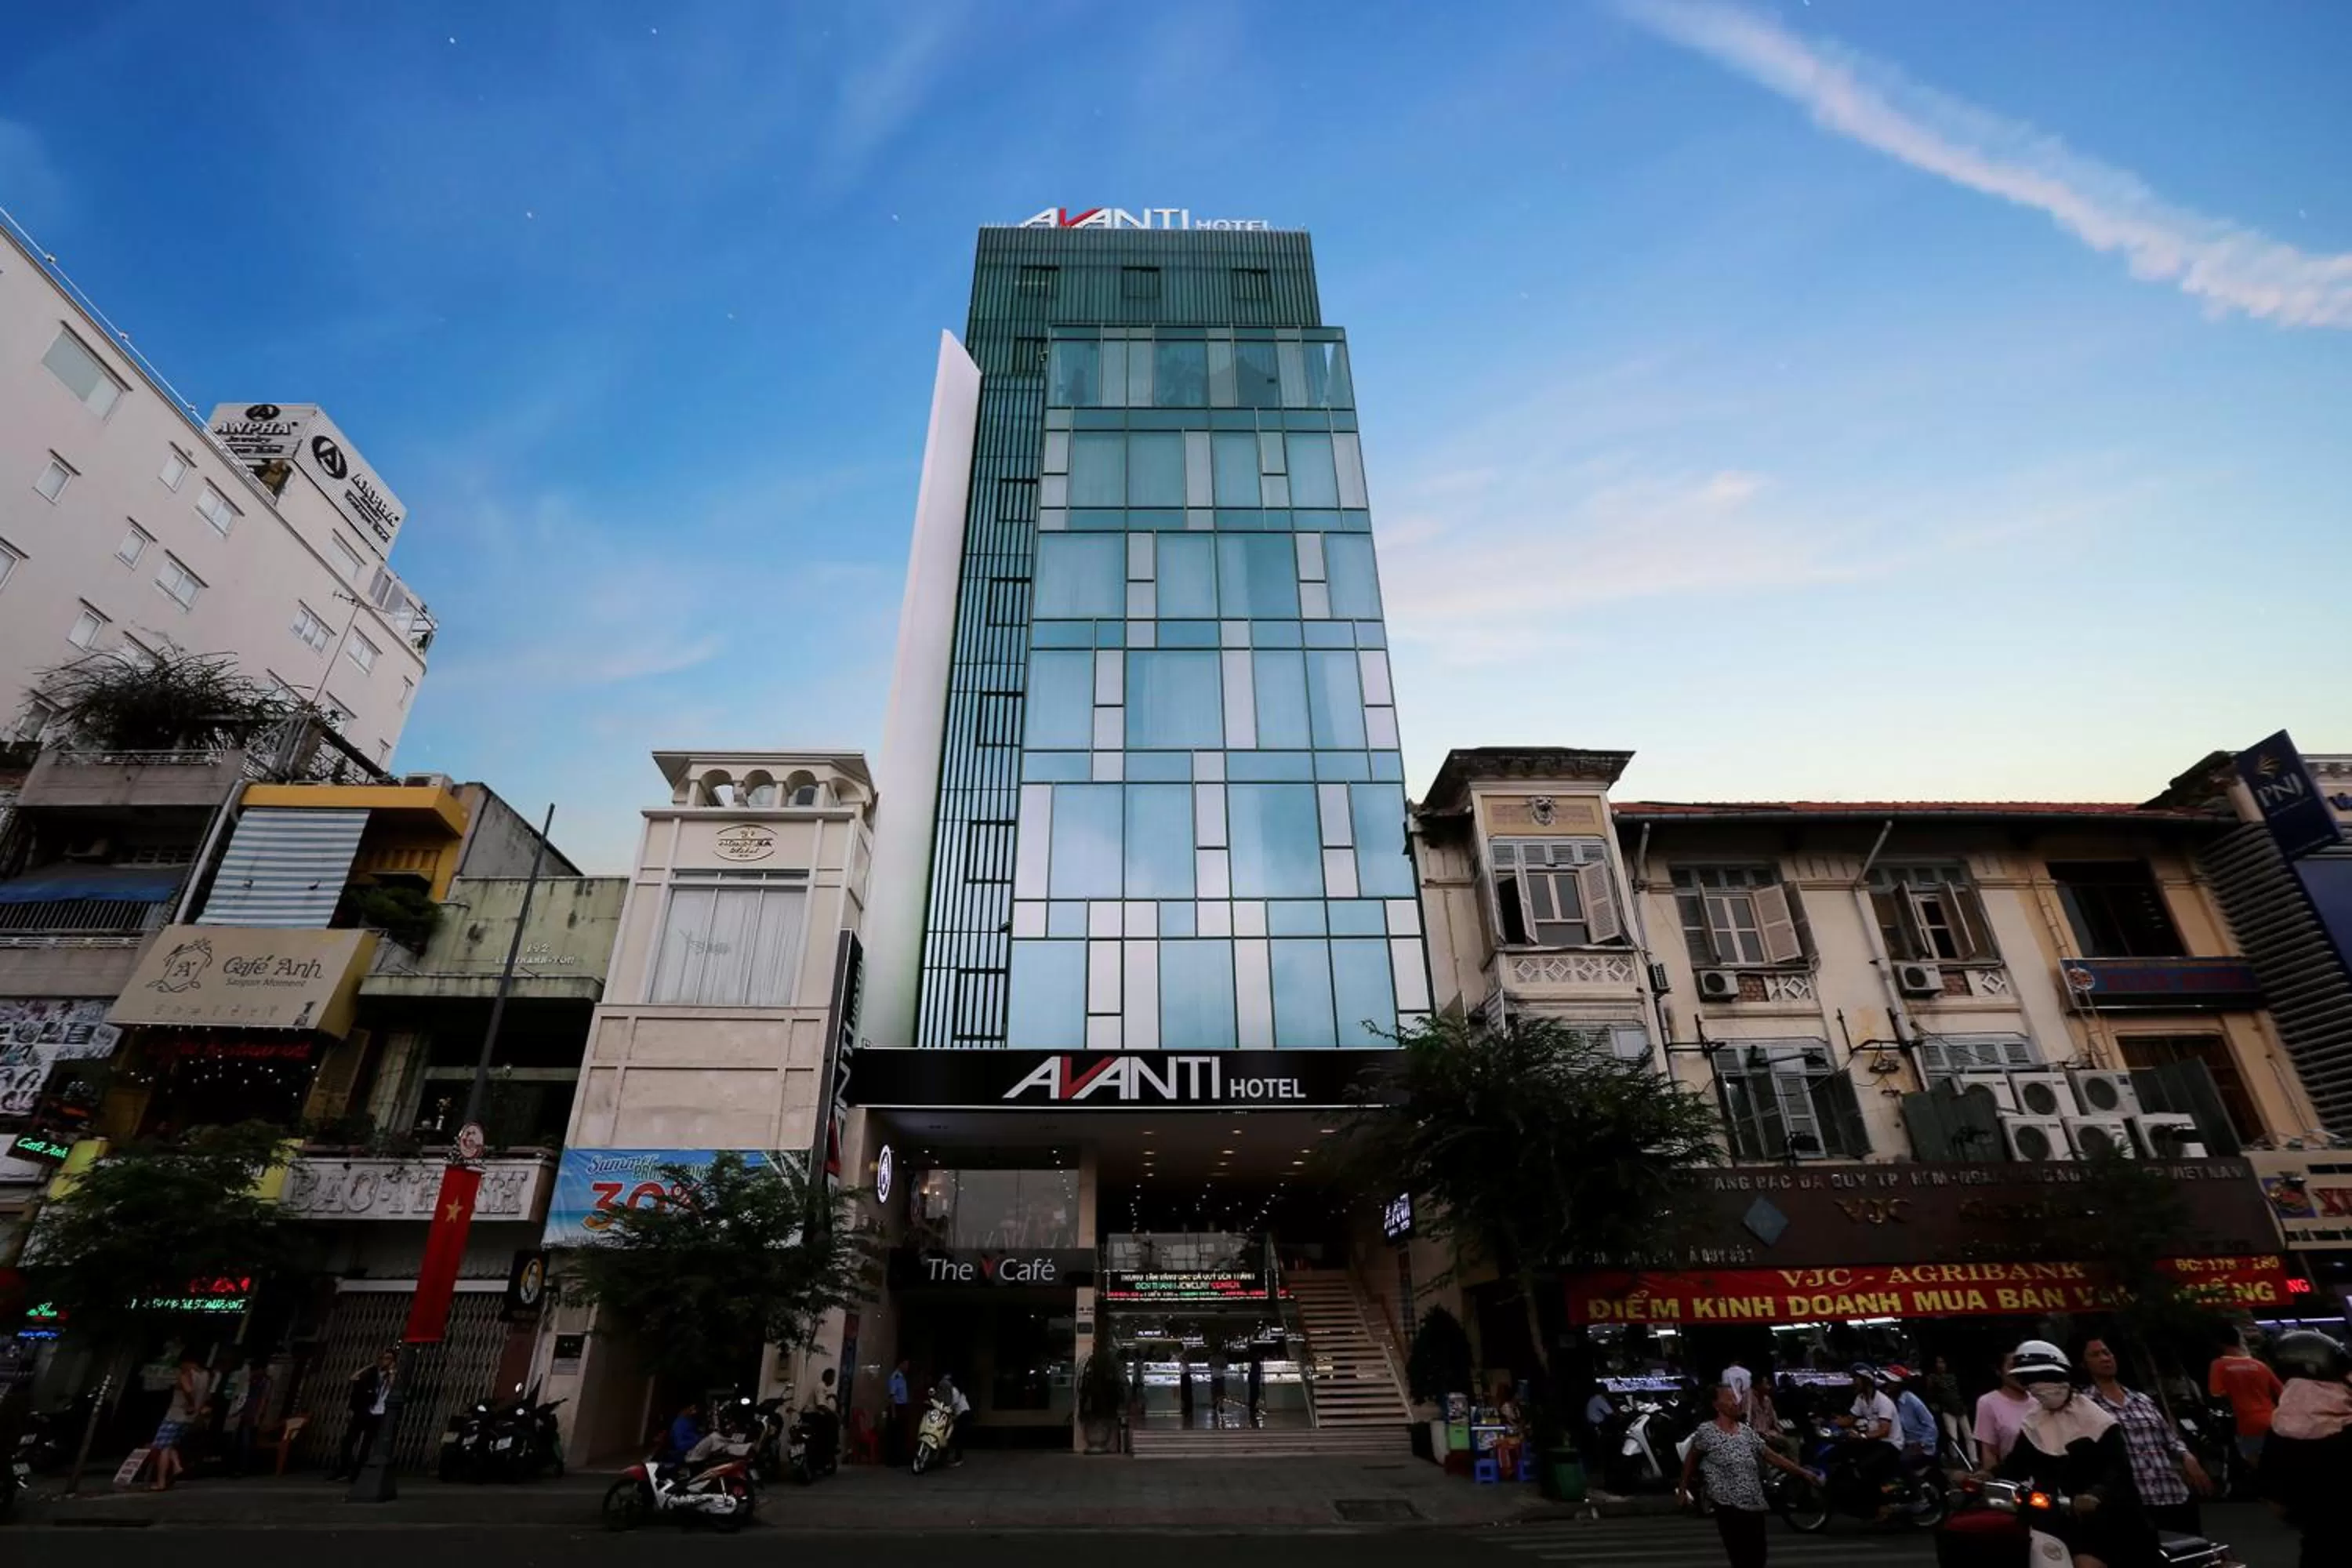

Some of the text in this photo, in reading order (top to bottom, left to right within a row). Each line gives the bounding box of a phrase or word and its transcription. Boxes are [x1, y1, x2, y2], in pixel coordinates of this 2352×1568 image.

[1019, 207, 1269, 231] AVANTI HOTEL
[214, 420, 290, 435] ANPHA
[2255, 771, 2306, 808] PNJ
[223, 954, 325, 979] Café Anh
[1002, 1056, 1307, 1100] AVANTI HOTEL
[927, 1258, 975, 1281] The
[999, 1258, 1057, 1281] Café
[1777, 1268, 1852, 1288] VJC
[1887, 1262, 2086, 1283] AGRIBANK
[1587, 1290, 1681, 1319] ĐIỂM
[1787, 1292, 1904, 1317] DOANH
[1912, 1288, 1988, 1312] MUA
[1995, 1282, 2065, 1309] BÁN
